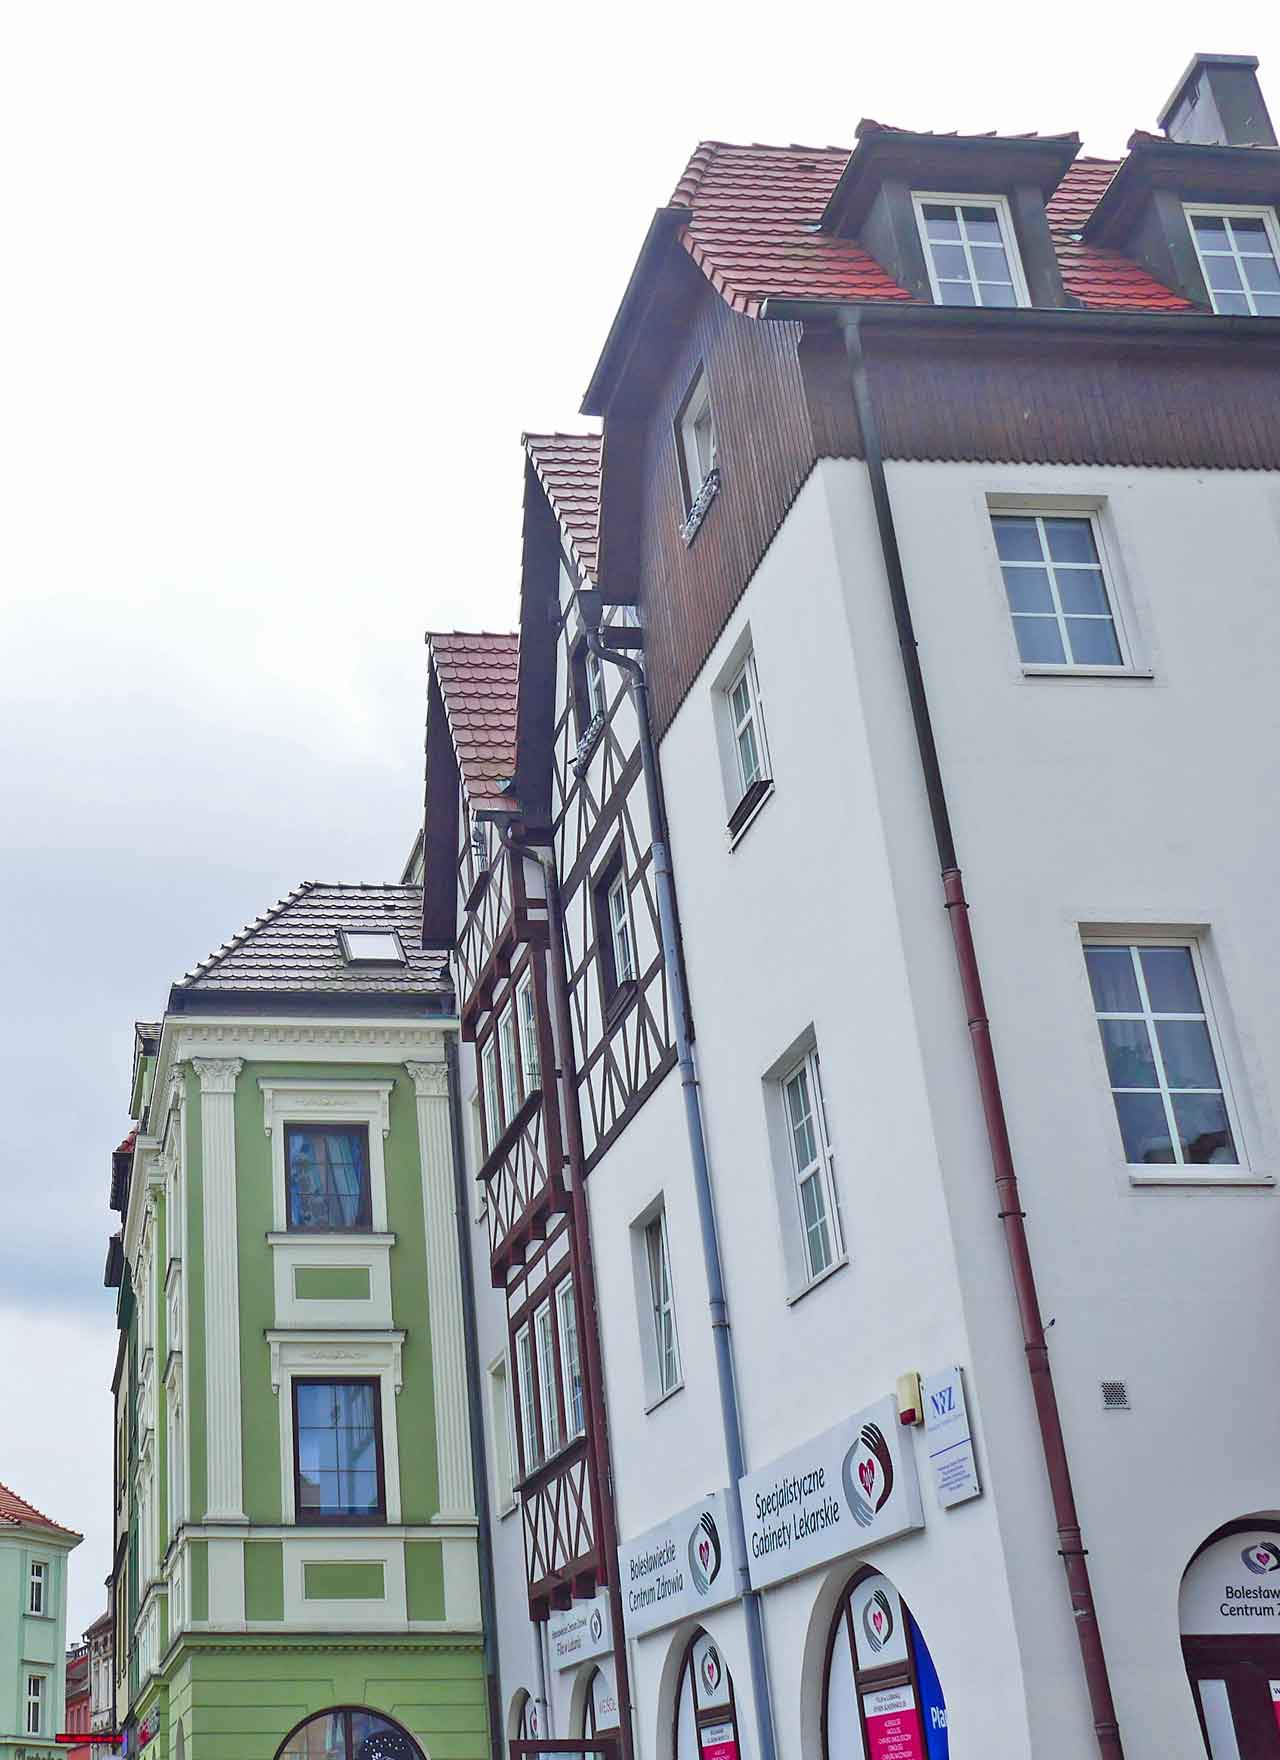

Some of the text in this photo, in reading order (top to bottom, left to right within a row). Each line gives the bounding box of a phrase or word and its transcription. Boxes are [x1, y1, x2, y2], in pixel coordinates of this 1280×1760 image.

[755, 1467, 825, 1523] Specjalistyczne
[752, 1495, 840, 1559] Gabinety Lekarskie
[628, 1568, 684, 1613] Centrum Zdrowia
[1219, 1602, 1275, 1617] Centrum
